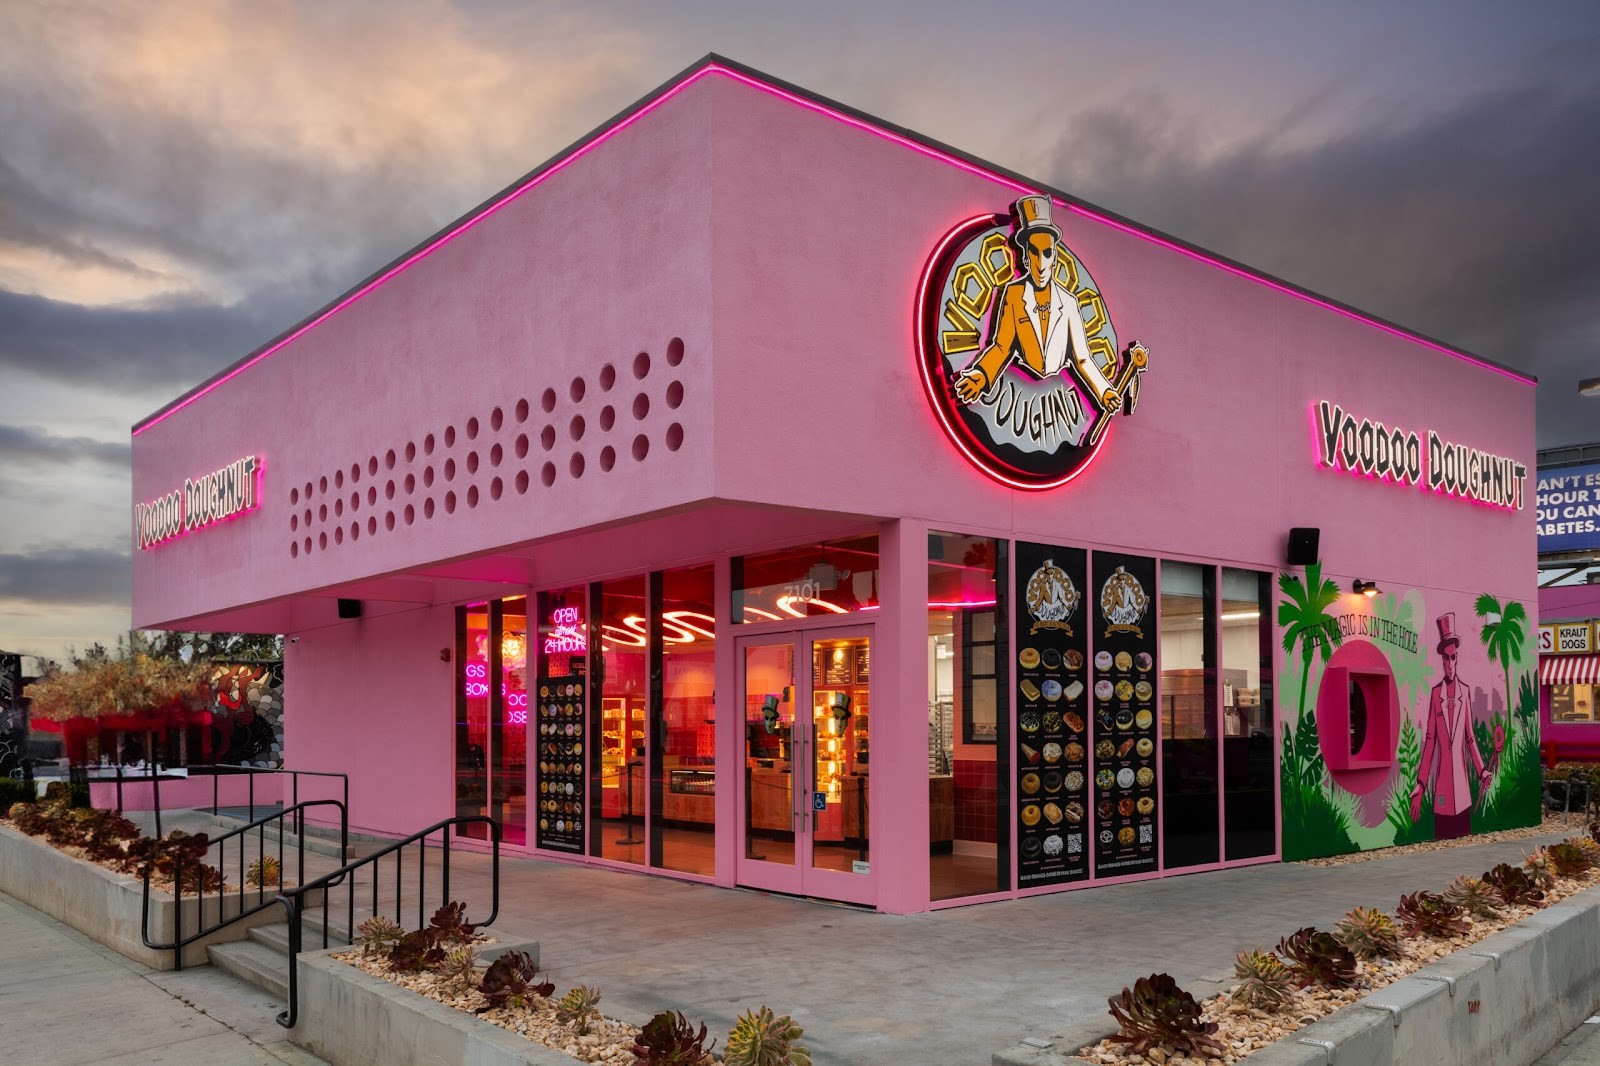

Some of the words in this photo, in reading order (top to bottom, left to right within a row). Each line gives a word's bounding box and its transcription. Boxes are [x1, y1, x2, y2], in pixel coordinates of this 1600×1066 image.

[1320, 400, 1421, 486] VOODOO
[1429, 430, 1527, 510] DOUGHNUT
[135, 489, 181, 550] VOODOO
[185, 455, 255, 531] DOUGHNUT
[1536, 490, 1589, 506] HOUR
[784, 579, 820, 604] 7101
[553, 607, 578, 623] OPEN
[1322, 613, 1356, 643] MAGIC
[1358, 614, 1368, 637] IS
[1369, 616, 1380, 639] IN
[1381, 618, 1398, 646] THE
[1398, 623, 1418, 654] HOLE
[1560, 628, 1587, 638] KRAUT
[1562, 639, 1586, 649] DOGS
